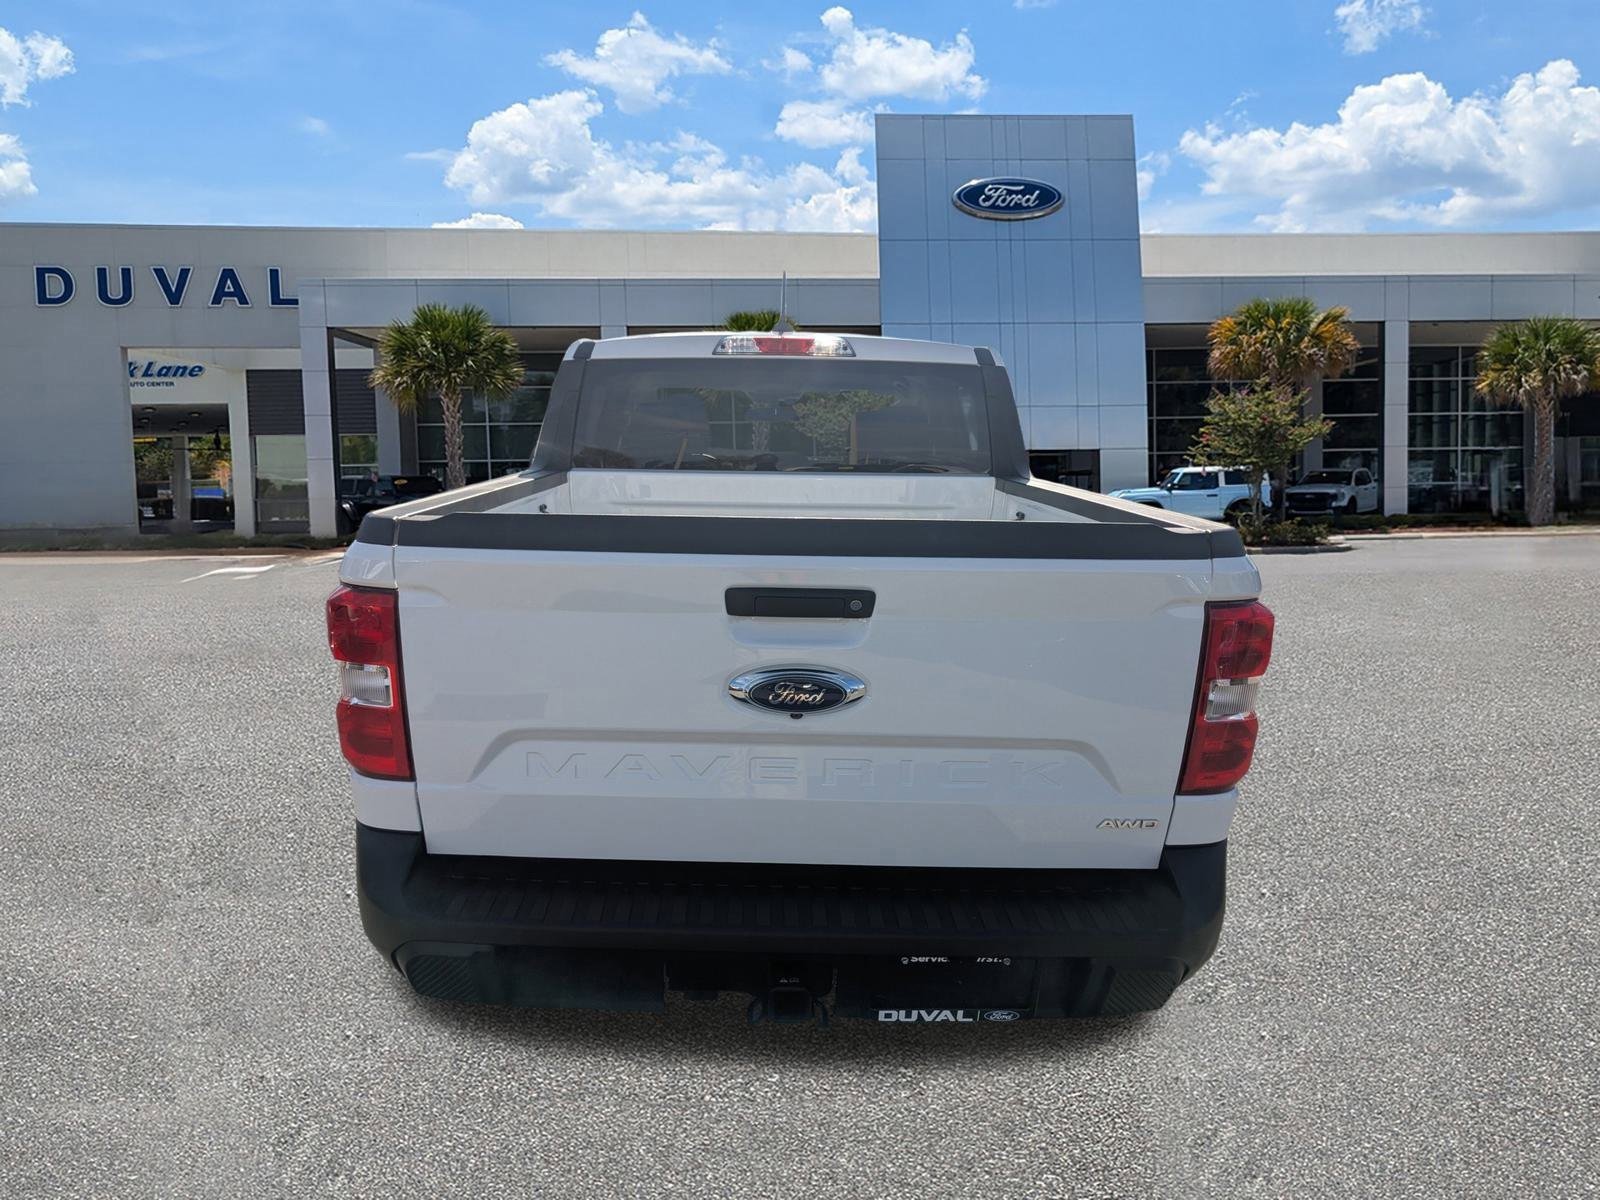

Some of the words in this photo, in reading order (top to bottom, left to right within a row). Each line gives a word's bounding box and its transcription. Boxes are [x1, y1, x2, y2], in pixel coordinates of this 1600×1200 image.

[978, 184, 1041, 207] Ford
[33, 265, 299, 307] DUVAL
[141, 361, 206, 378] Lane
[768, 681, 826, 706] Ford
[525, 751, 1064, 787] MAVERICK
[1096, 818, 1160, 829] AWD
[877, 1009, 974, 1022] DUVAL
